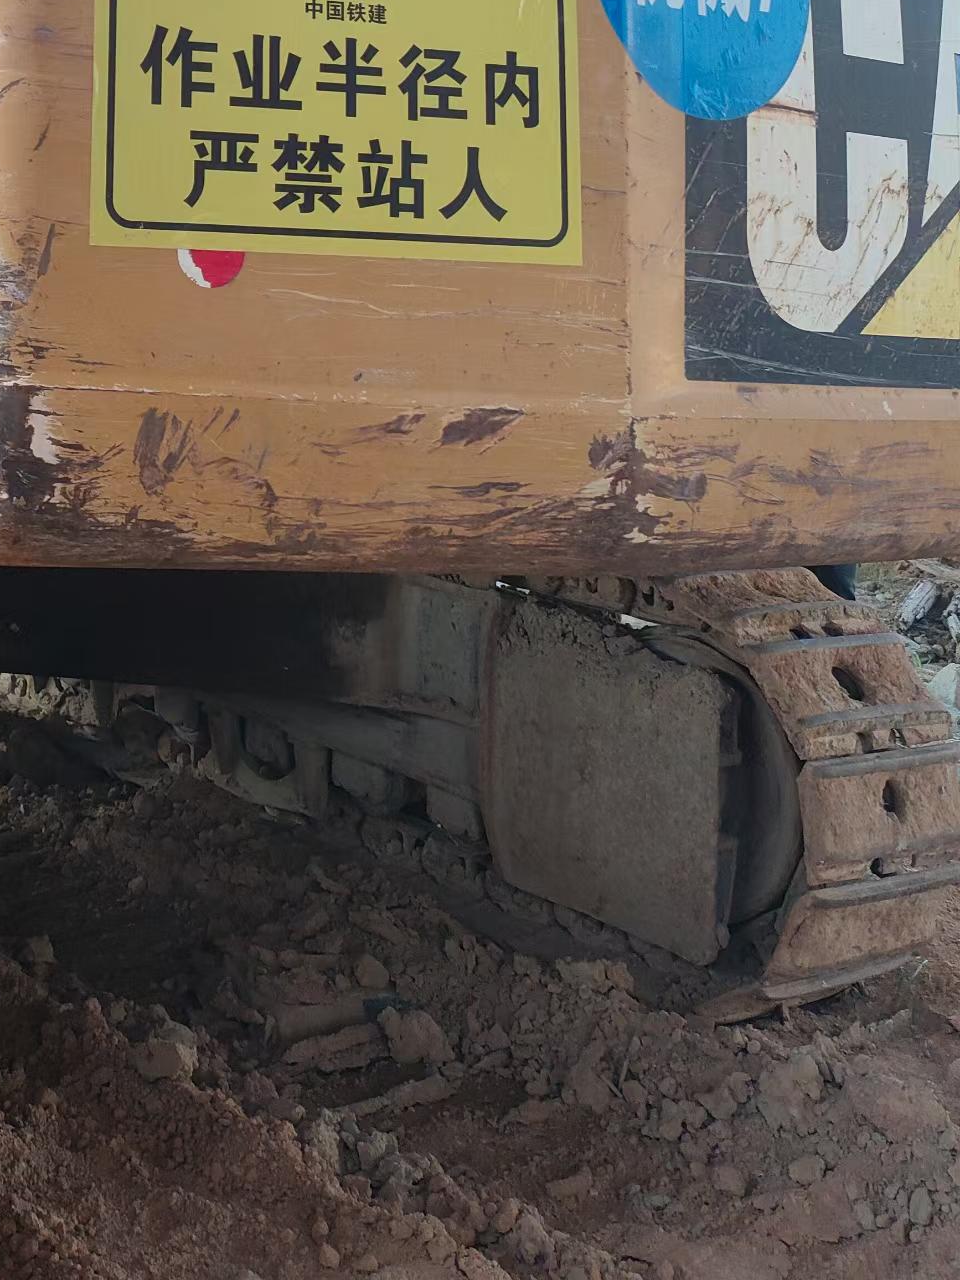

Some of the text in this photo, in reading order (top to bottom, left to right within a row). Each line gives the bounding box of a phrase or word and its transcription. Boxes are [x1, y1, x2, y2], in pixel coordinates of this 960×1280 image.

[305, 0, 387, 24] 中国铁建
[140, 24, 540, 128] 作业半径内
[184, 130, 508, 222] 严禁站人
